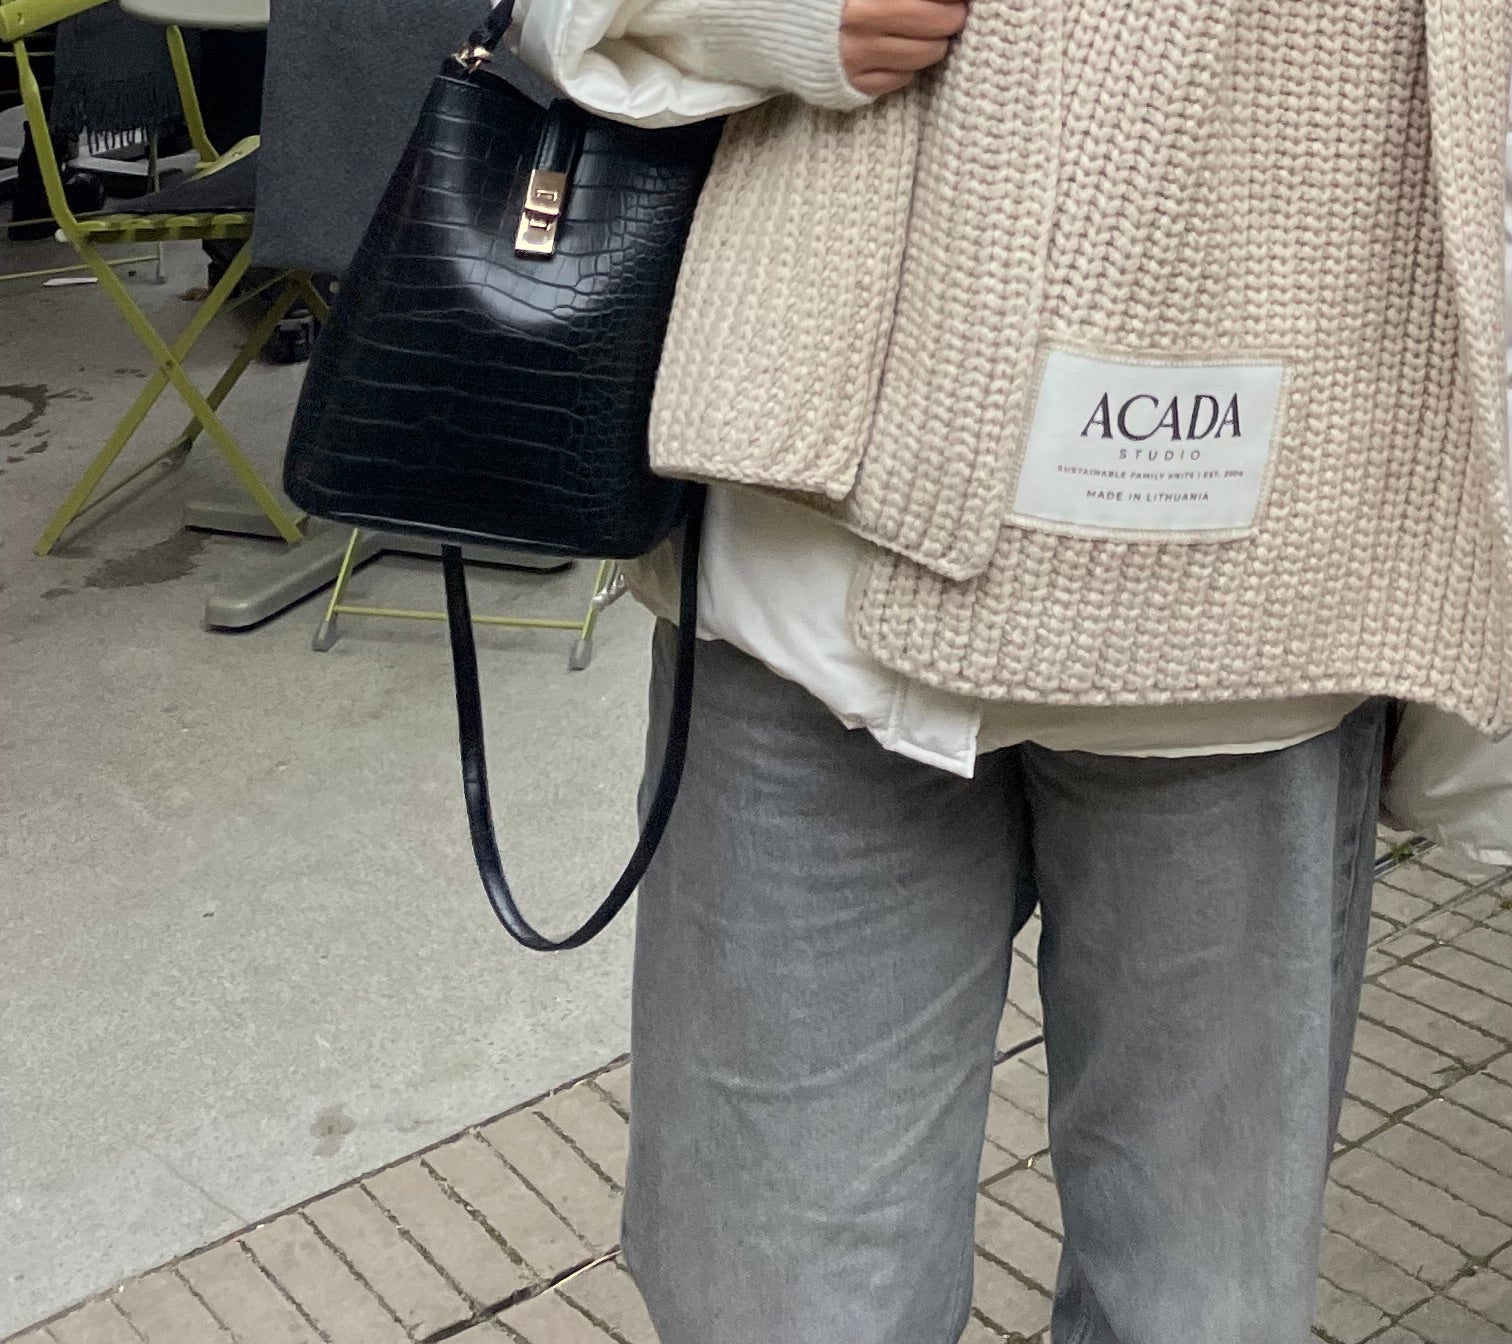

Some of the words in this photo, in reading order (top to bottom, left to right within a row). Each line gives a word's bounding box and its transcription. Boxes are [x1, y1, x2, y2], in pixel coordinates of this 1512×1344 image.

[1080, 391, 1242, 442] ACADA
[1119, 448, 1201, 462] STUDIO
[1057, 464, 1127, 480] SUSTAINABLE
[1130, 471, 1165, 481] FAMILY
[1086, 489, 1124, 502] MADE
[1128, 492, 1142, 502] IN
[1145, 492, 1210, 503] LITHUANIA
